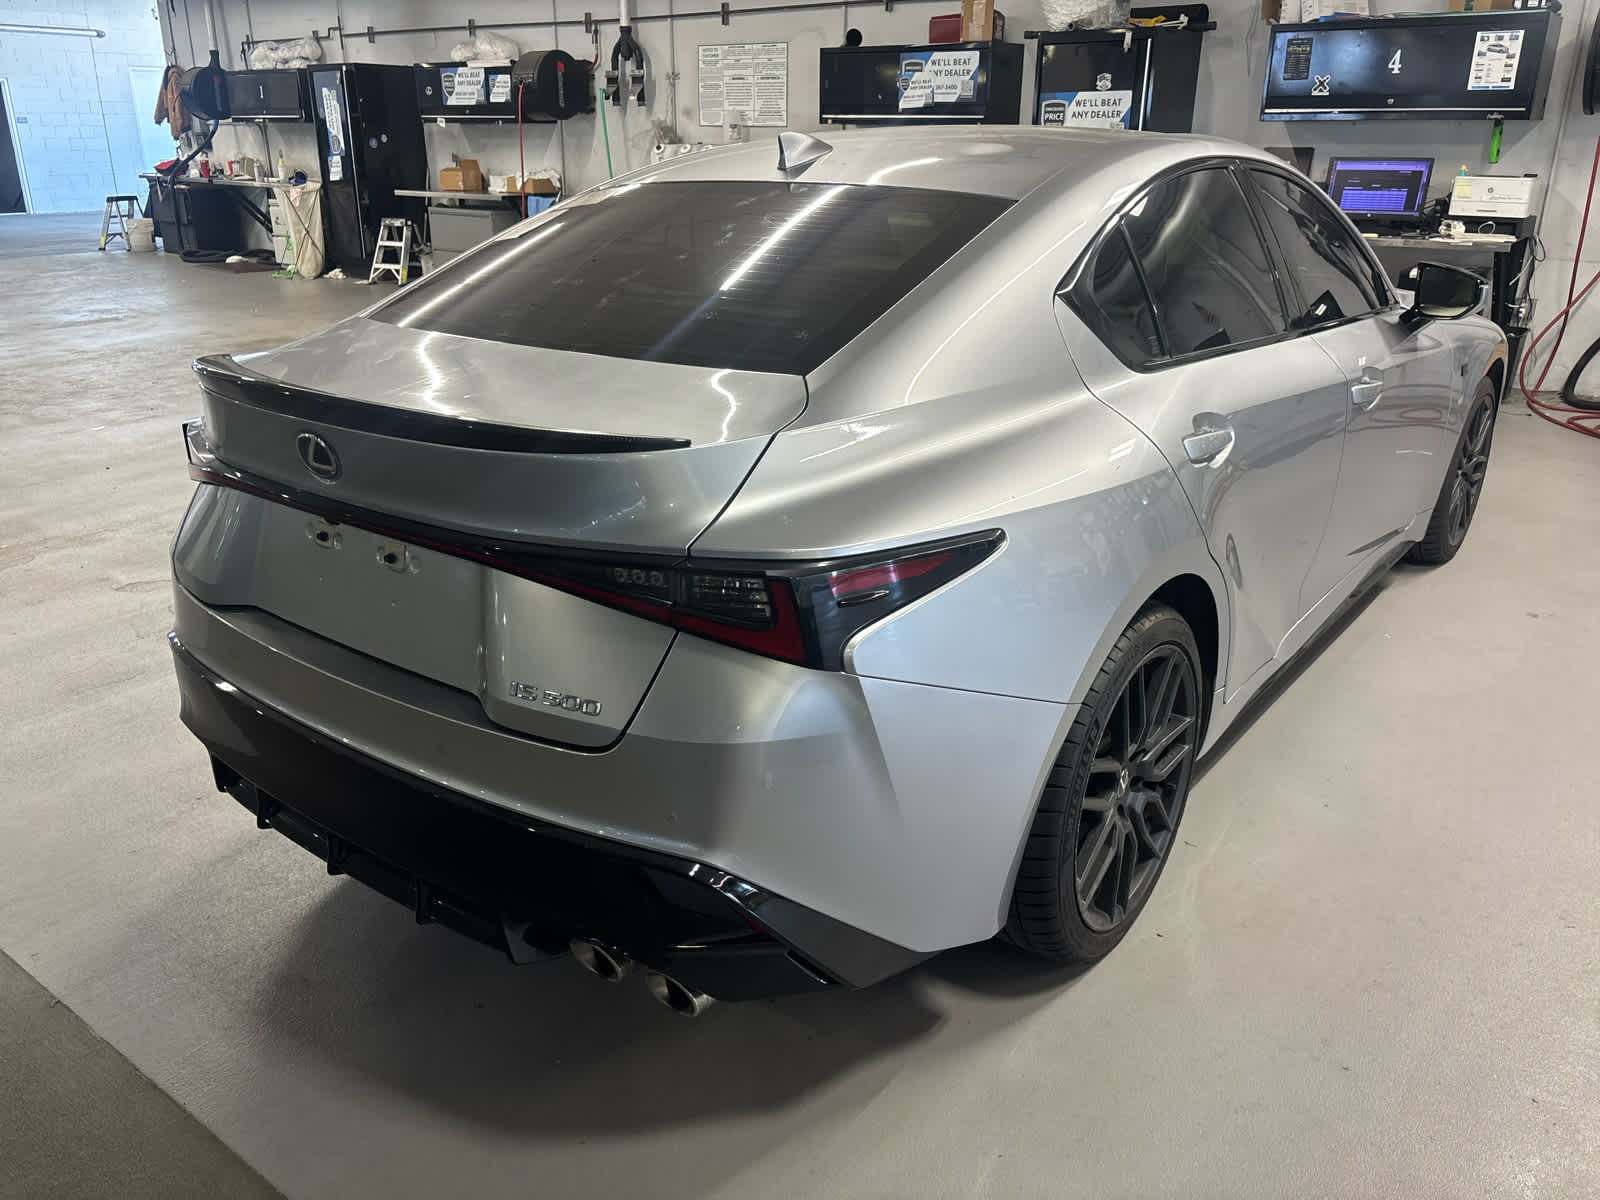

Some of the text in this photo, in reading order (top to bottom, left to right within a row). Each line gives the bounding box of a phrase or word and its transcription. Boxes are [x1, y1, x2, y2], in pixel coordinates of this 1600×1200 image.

[931, 58, 951, 67] WE'LL
[953, 58, 971, 66] BEAT
[1388, 49, 1402, 74] 4
[944, 69, 971, 77] DEALER
[1075, 98, 1122, 107] WE'LL BEAT
[1044, 112, 1064, 120] PRICE
[1072, 110, 1121, 119] ANY DEALER
[509, 681, 603, 716] IS 500
